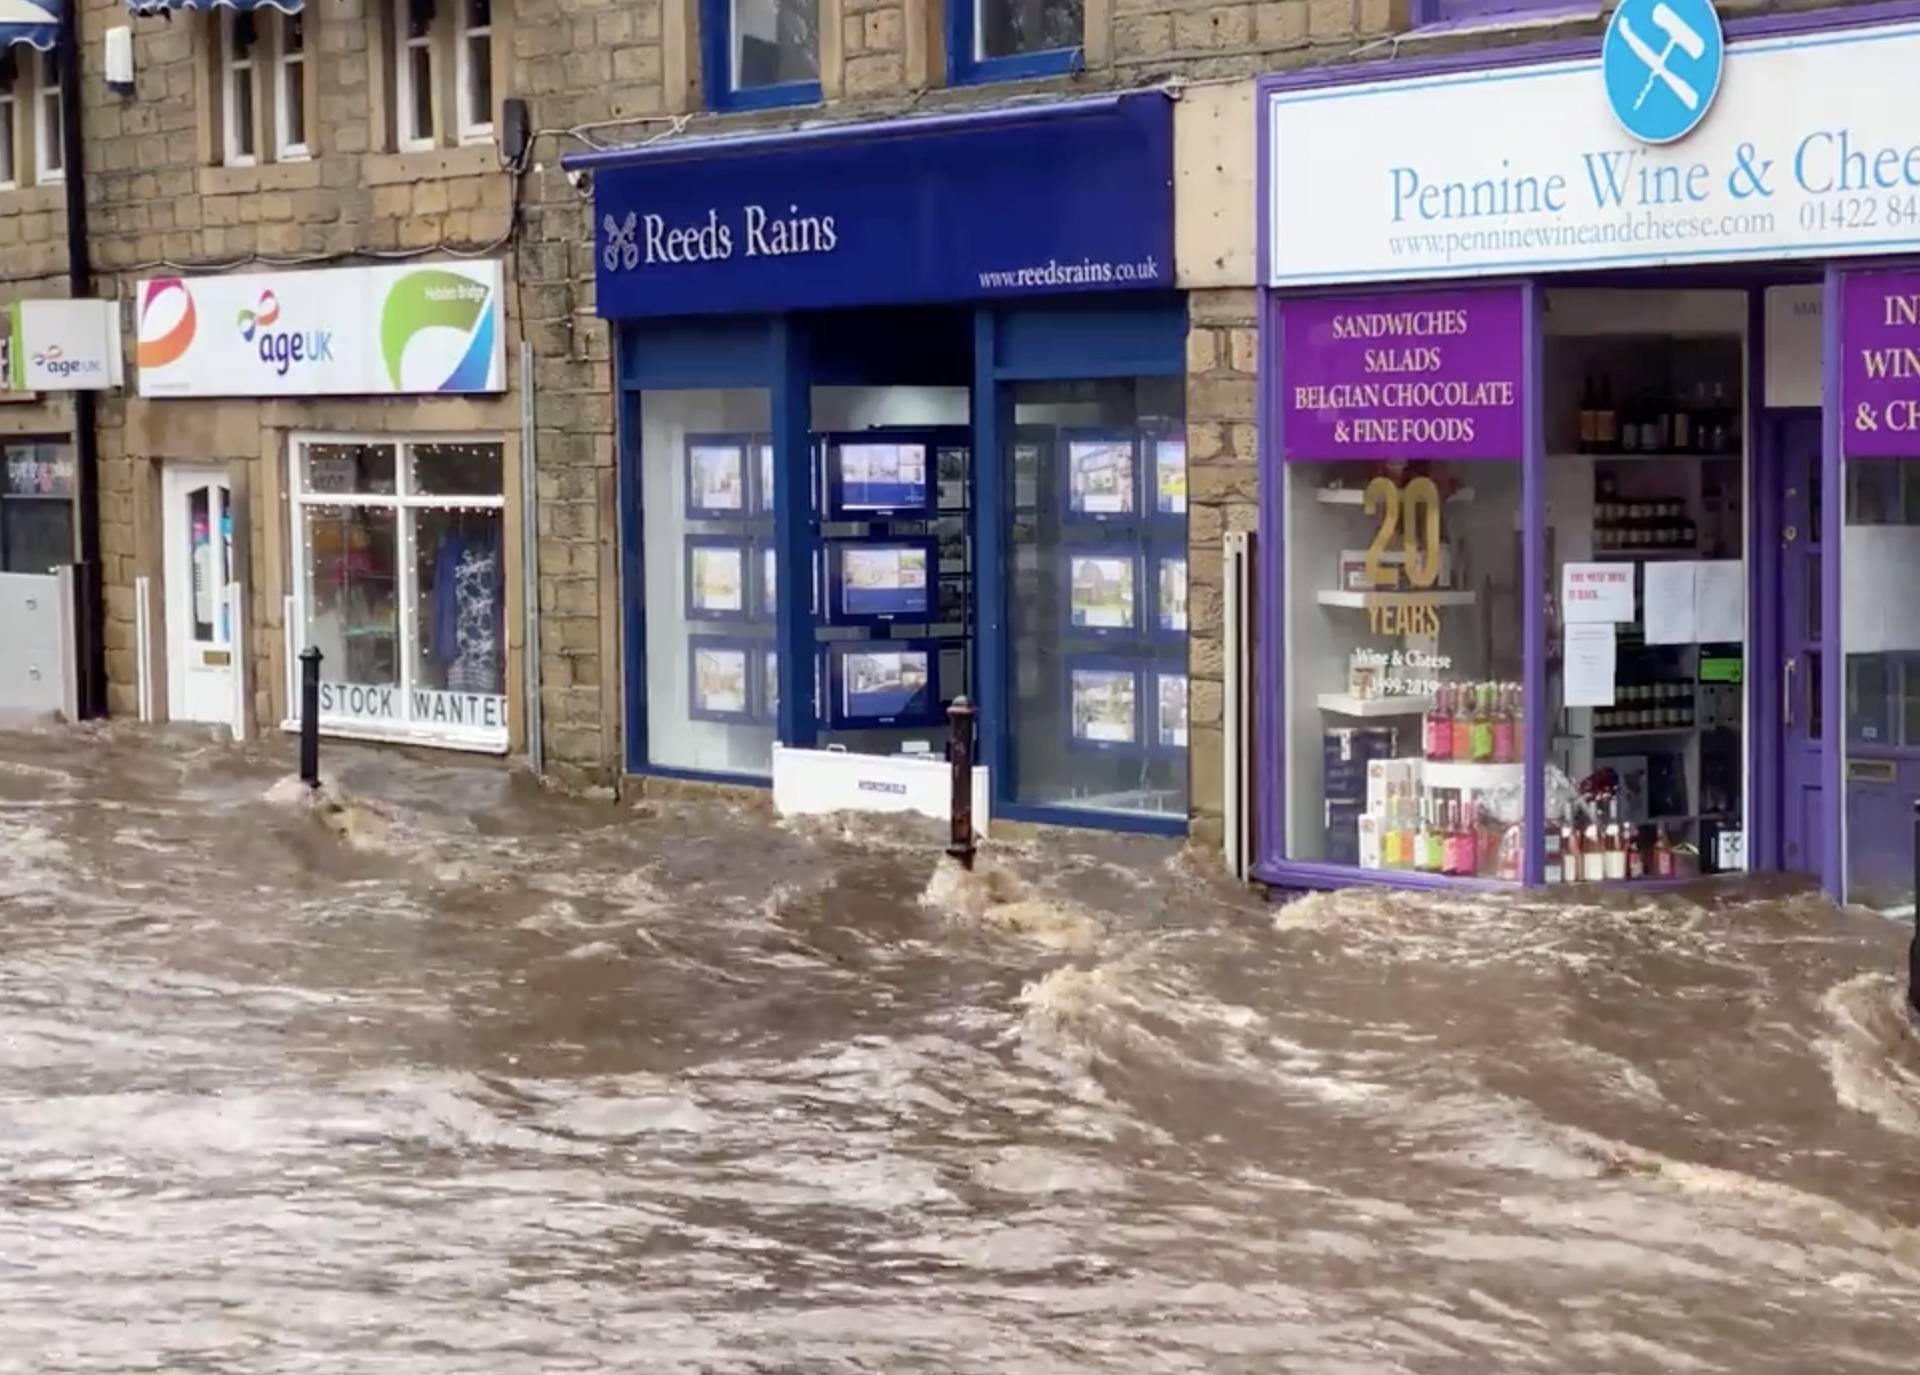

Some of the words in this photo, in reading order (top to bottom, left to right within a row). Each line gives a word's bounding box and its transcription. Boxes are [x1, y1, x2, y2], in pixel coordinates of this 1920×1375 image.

[1389, 158, 1566, 222] Pennine
[1582, 147, 1710, 208] Wine
[1728, 142, 1775, 198] &
[643, 208, 733, 264] Reeds
[744, 203, 838, 258] Rains
[1388, 211, 1775, 263] www.penninewineandcheese.com
[1799, 196, 1878, 231] 01422
[978, 255, 1159, 288] www.reedsrains.co.uk
[1332, 309, 1468, 339] SANDWICHES
[1364, 346, 1442, 373] SALADS
[1294, 383, 1380, 410] BELGIAN
[1382, 381, 1514, 408] CHOCOLATE
[1334, 419, 1350, 442] &
[1353, 418, 1399, 442] FINE
[1402, 417, 1475, 442] FOODS
[1854, 400, 1879, 432] &
[1363, 476, 1439, 588] 20
[1368, 598, 1440, 637] YEARS
[1355, 647, 1389, 666] Wine
[1391, 650, 1404, 667] &
[1405, 650, 1452, 669] Cheese
[320, 683, 394, 718] STOCK
